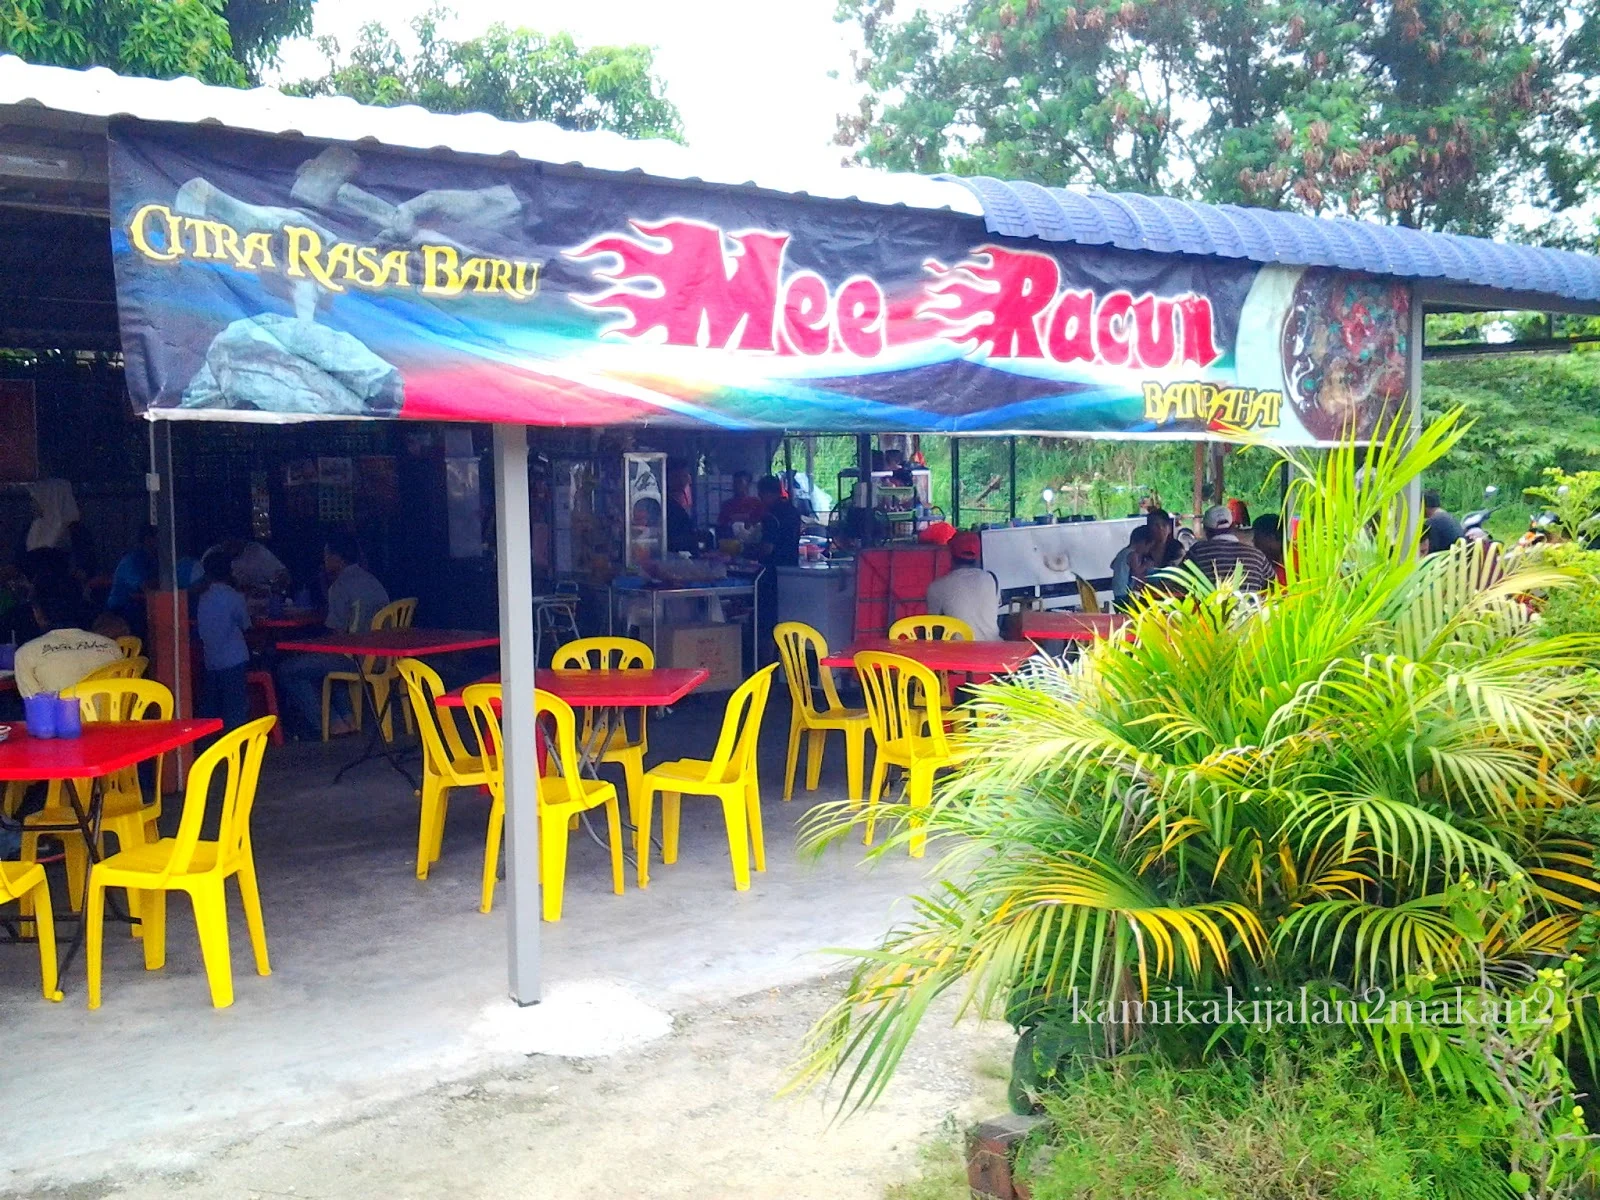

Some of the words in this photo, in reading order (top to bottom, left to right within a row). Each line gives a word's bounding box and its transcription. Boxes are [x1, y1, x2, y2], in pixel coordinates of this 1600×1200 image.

[130, 204, 276, 270] CITRA
[283, 224, 412, 292] RASA
[421, 244, 542, 300] BARU
[560, 216, 890, 360] Mee
[918, 244, 1223, 370] Racun
